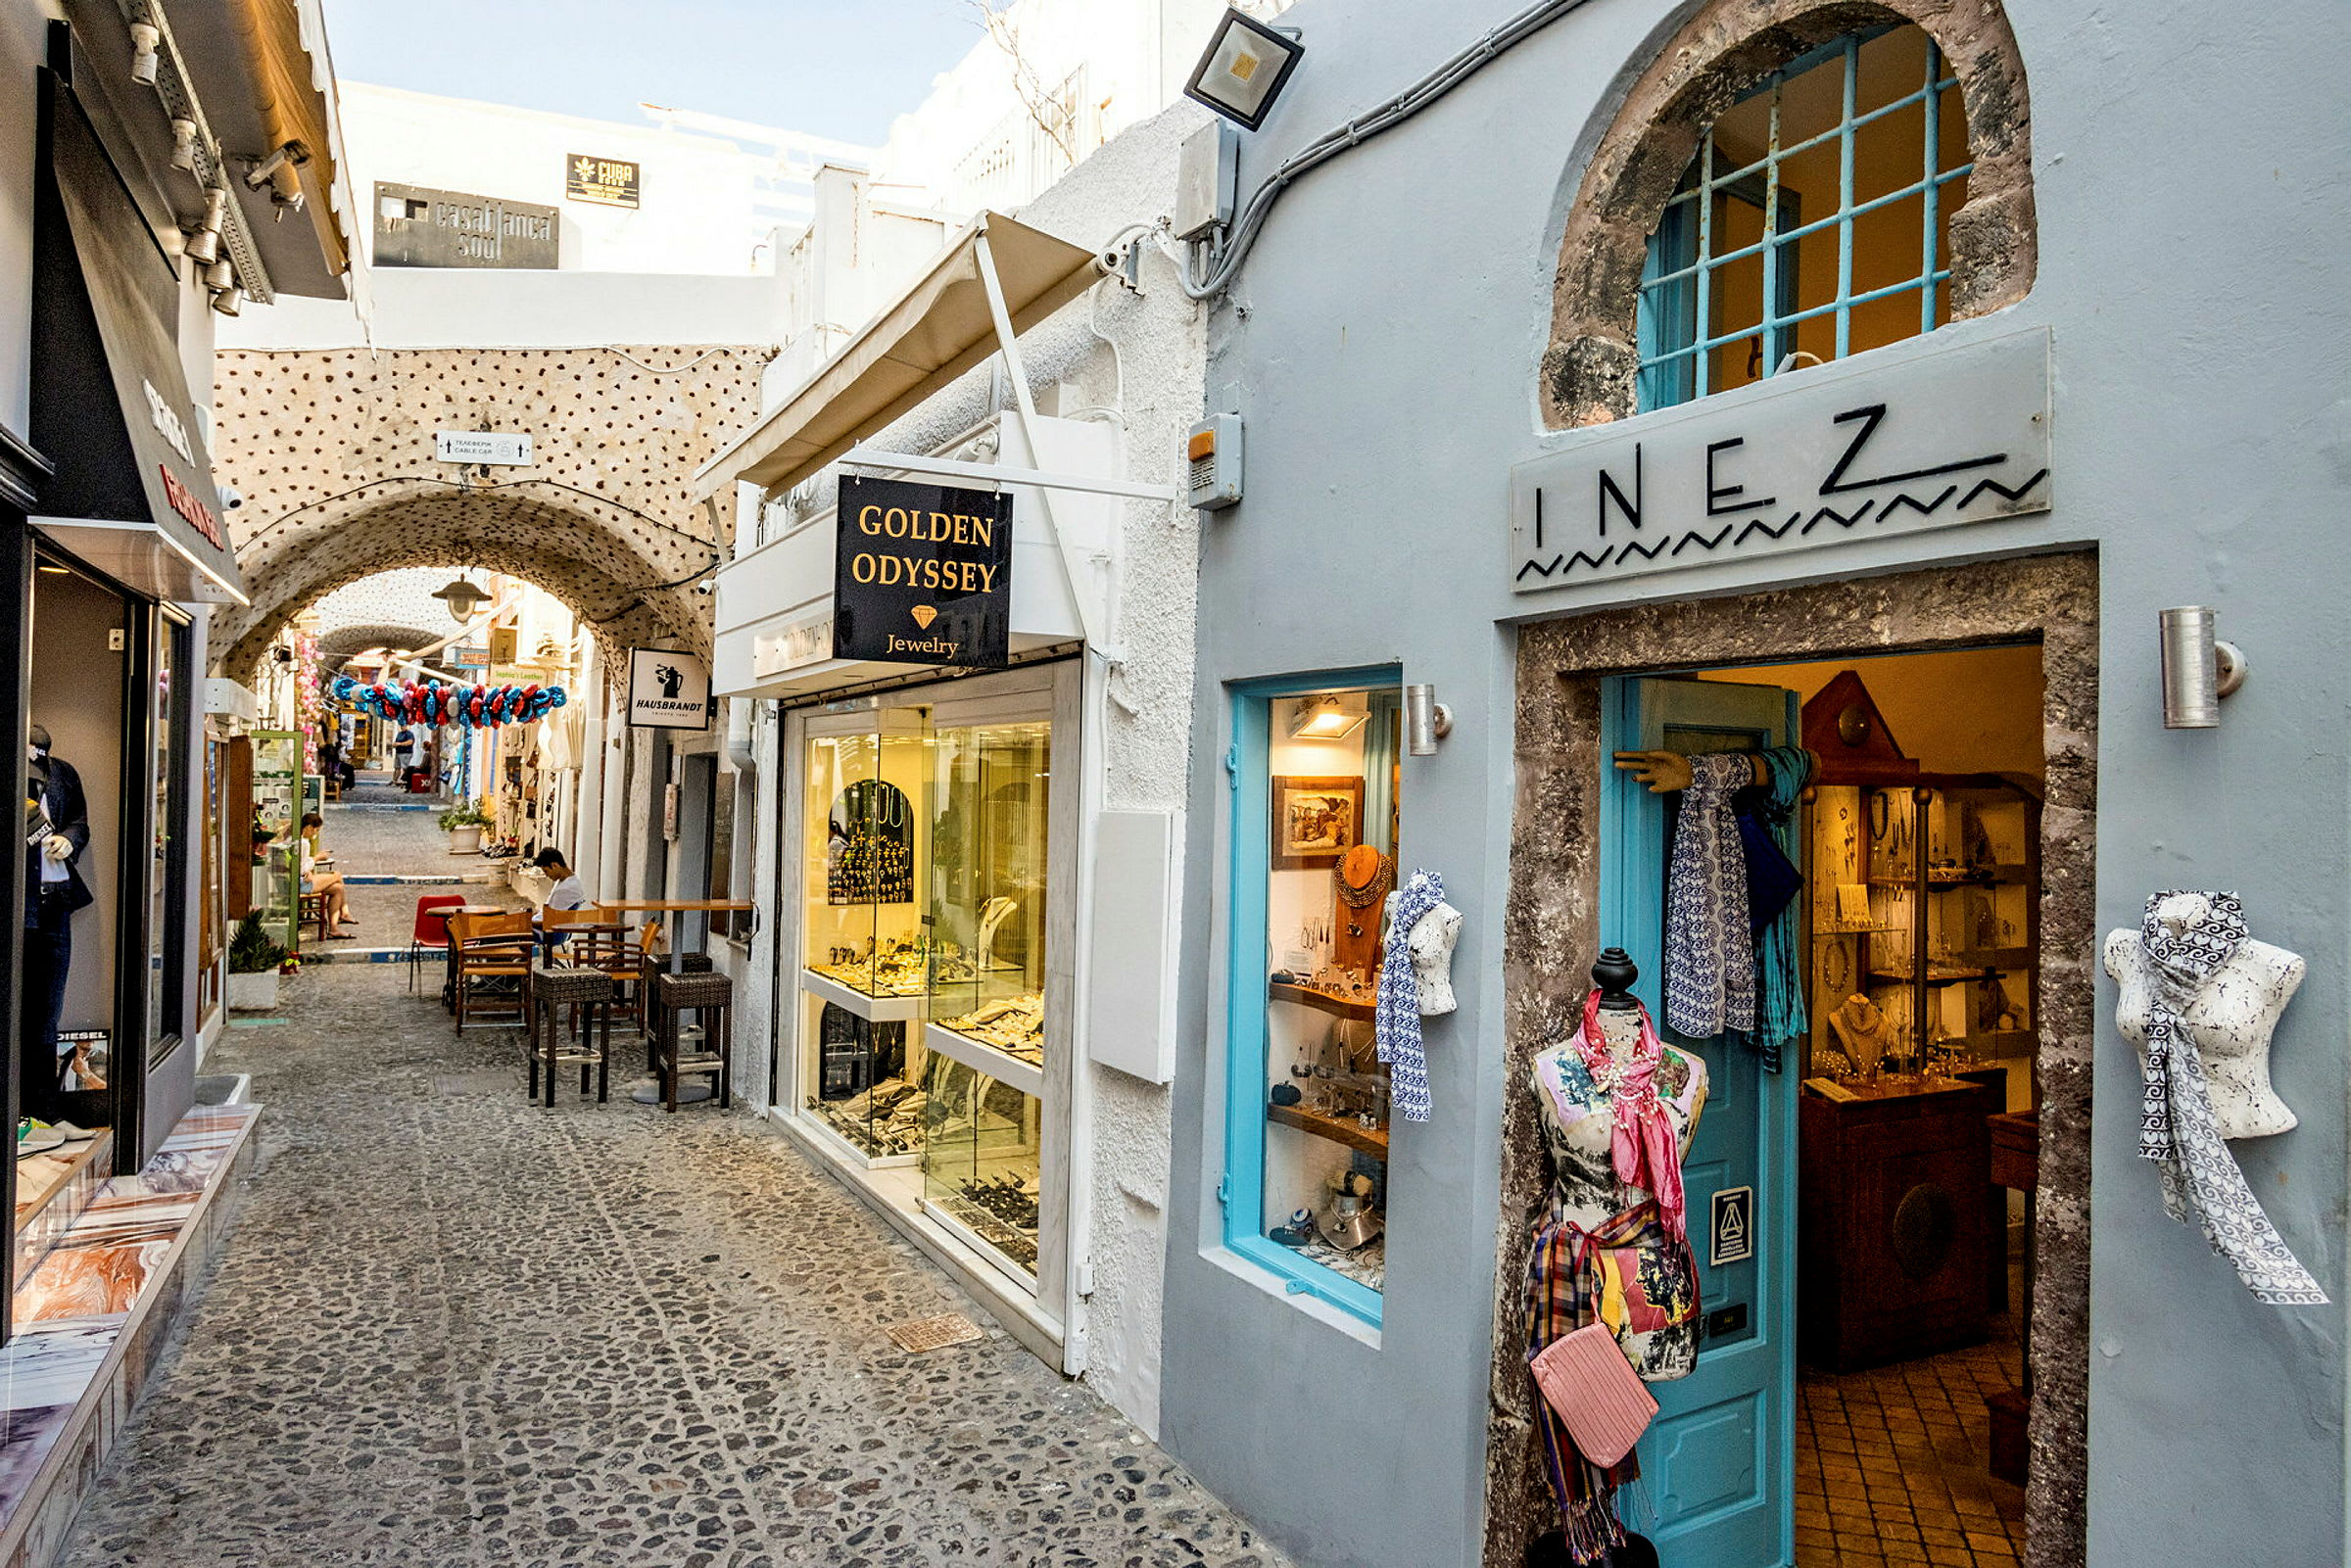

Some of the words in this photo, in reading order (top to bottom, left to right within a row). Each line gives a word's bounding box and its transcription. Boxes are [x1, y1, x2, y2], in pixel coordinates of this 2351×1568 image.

[598, 162, 633, 181] CUBA
[436, 200, 552, 242] casablanca
[457, 232, 502, 261] soul
[1536, 403, 2007, 548] INEZ
[859, 504, 994, 547] GOLDEN
[851, 552, 997, 594] ODYSSEY
[887, 634, 959, 659] Jewelry
[636, 698, 703, 712] HAUSBRANDT
[26, 822, 53, 847] DIESEL
